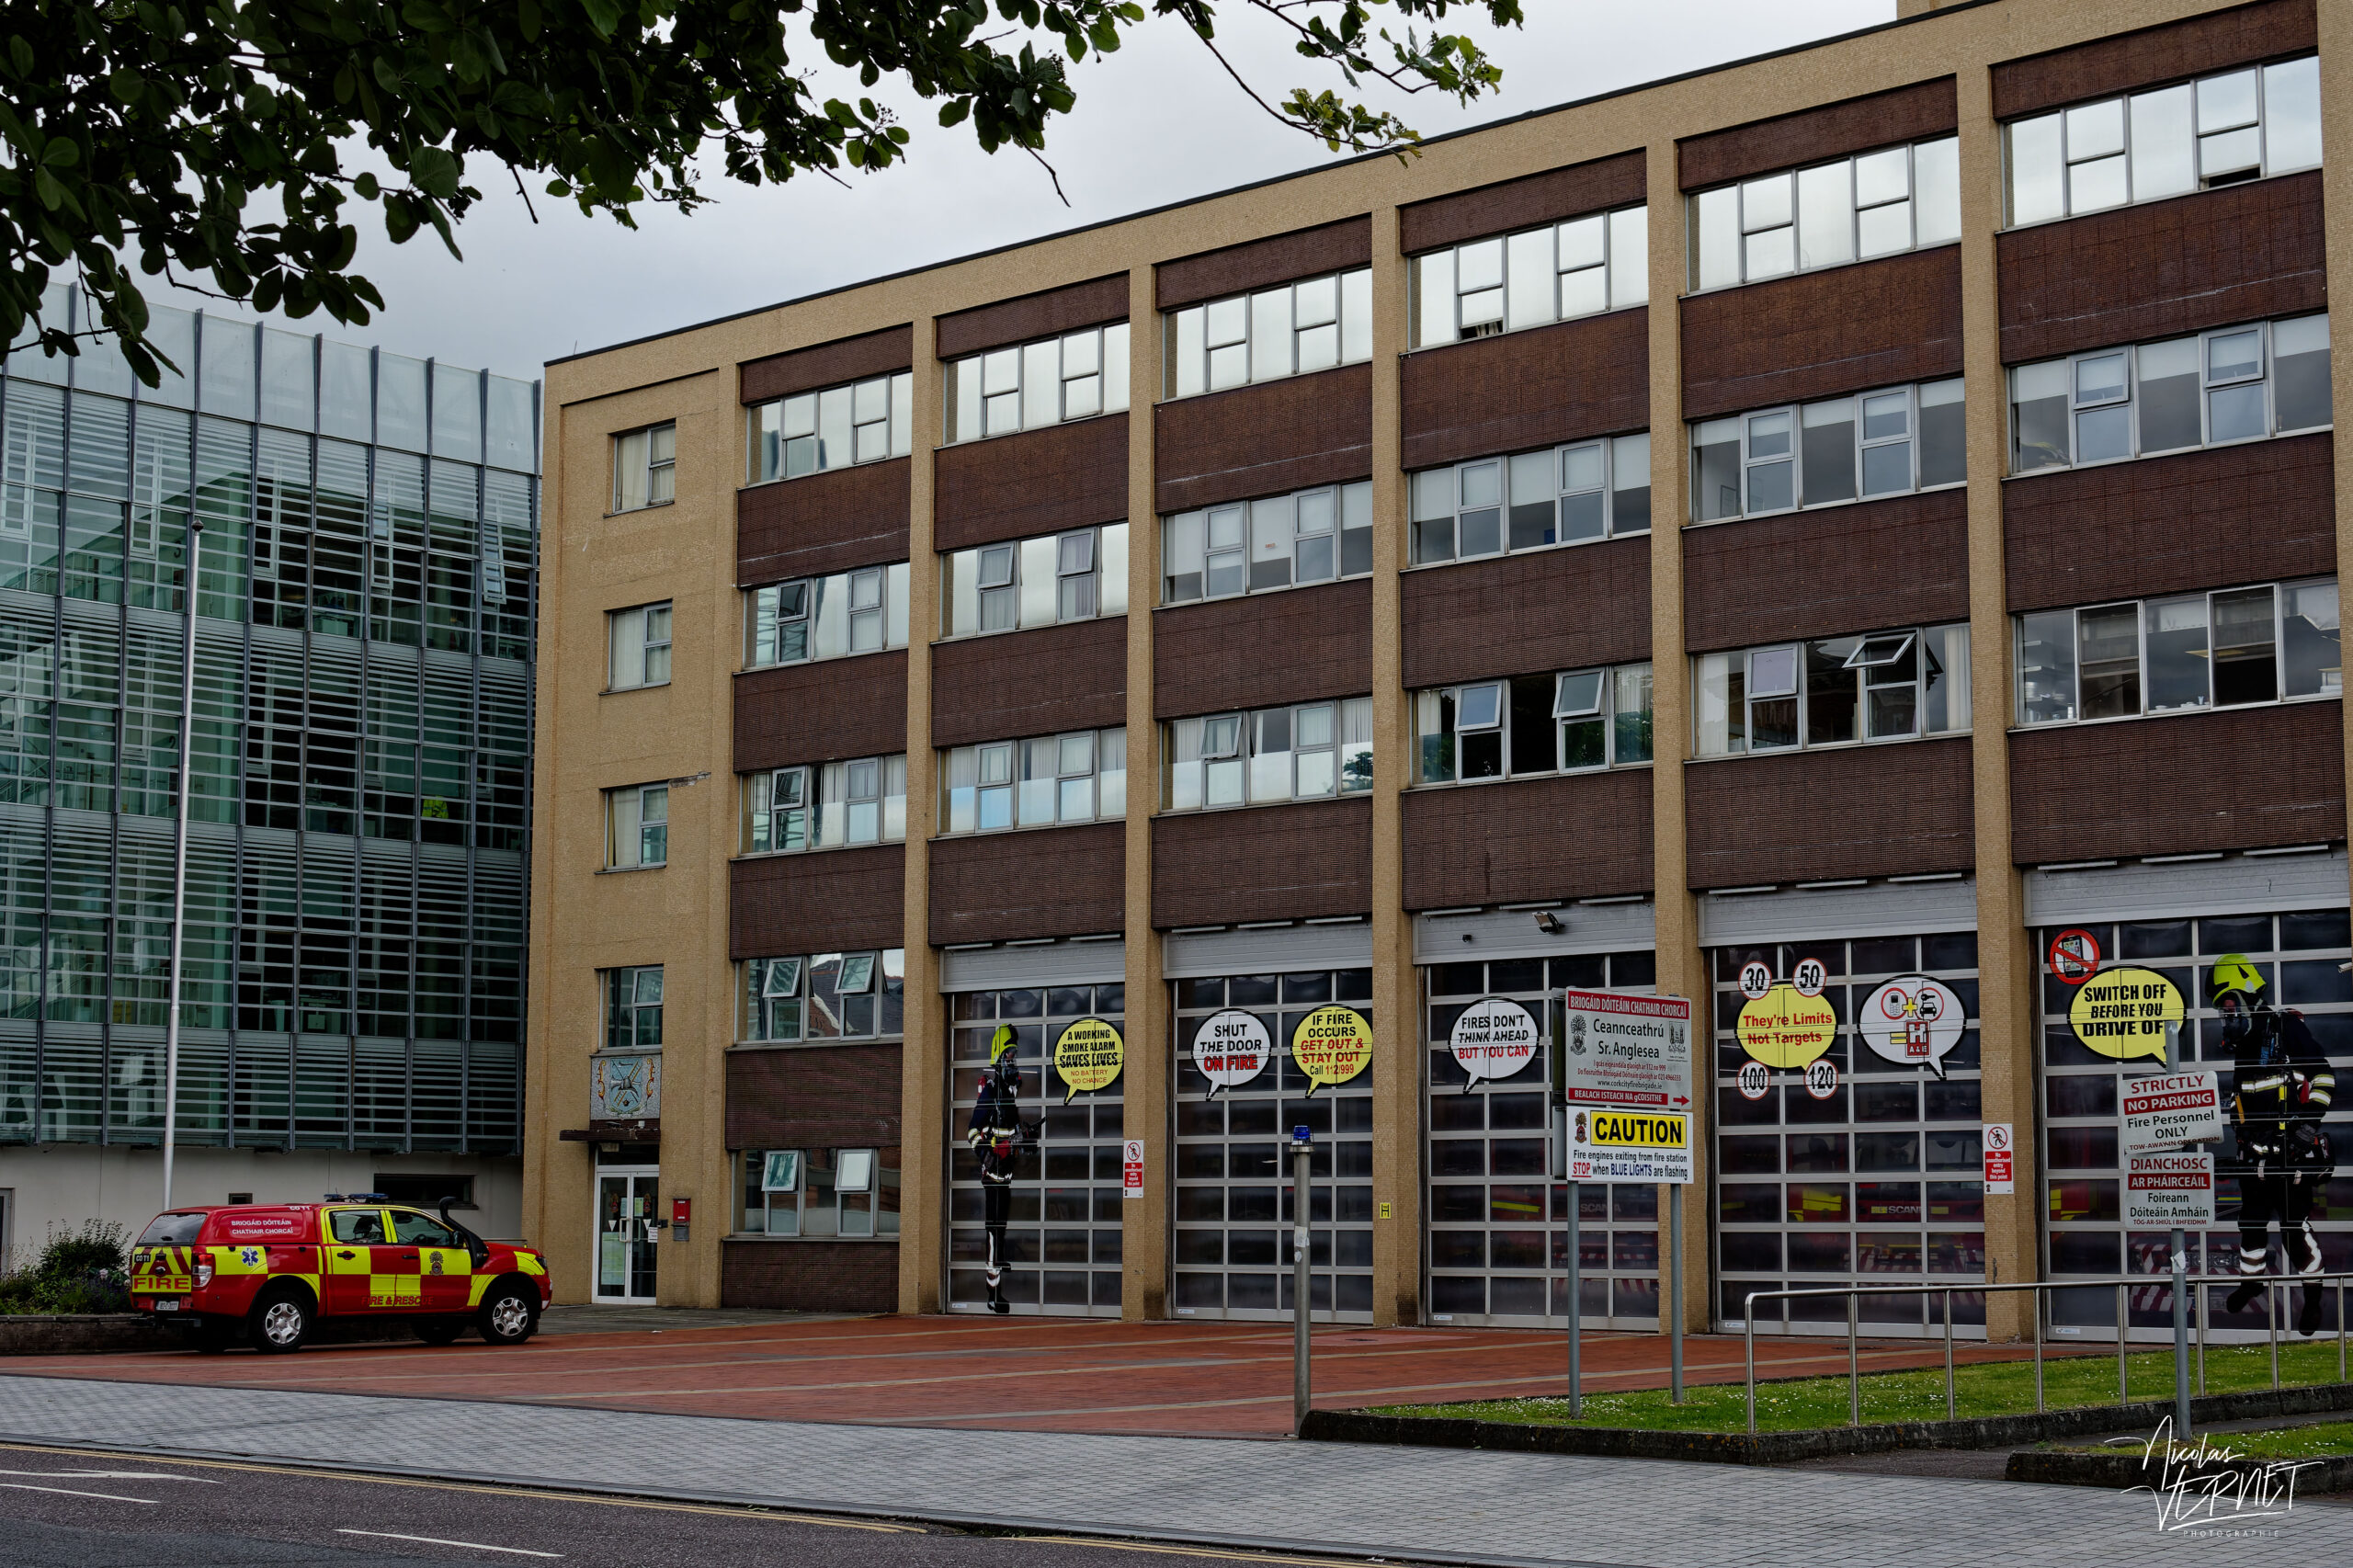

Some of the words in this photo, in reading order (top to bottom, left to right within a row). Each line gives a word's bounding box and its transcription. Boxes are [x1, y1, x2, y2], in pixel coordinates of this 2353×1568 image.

[1745, 968, 1766, 991] 30
[1799, 964, 1820, 988] 50
[2084, 985, 2139, 1002] SWITCH
[2143, 984, 2166, 999] OFF
[1570, 995, 1600, 1009] BRIOGÁID
[1601, 997, 1630, 1012] DÓITEÁIN
[1631, 1003, 1661, 1016] CHATHAIR
[1661, 1004, 1687, 1017] CHORCAÍ
[2091, 1004, 2135, 1018] BEFORE
[2138, 1003, 2163, 1017] YOU
[1313, 1015, 1323, 1026] IF
[1326, 1013, 1352, 1025] FIRE
[1461, 1017, 1490, 1029] FIRES
[1495, 1015, 1525, 1028] DON'T
[1744, 1015, 1790, 1028] They're
[1793, 1012, 1833, 1025] Limits
[1068, 1032, 1073, 1040] A
[1074, 1029, 1110, 1040] WORKING
[1214, 1024, 1247, 1038] SHUT
[1308, 1026, 1356, 1038] OCCURS
[1593, 1018, 1665, 1038] Ceannceathrú
[1909, 1023, 1927, 1043] H
[2083, 1021, 2136, 1037] DRIVE
[2142, 1020, 2164, 1035] OF
[1459, 1031, 1490, 1043] THINK
[1493, 1029, 1529, 1042] AHEAD
[1747, 1033, 1769, 1045] Not
[1773, 1031, 1823, 1046] Targets
[1063, 1042, 1089, 1052] SMOKE
[1090, 1041, 1116, 1051] ALARM
[1200, 1040, 1224, 1052] THE
[1227, 1039, 1262, 1051] DOOR
[1300, 1040, 1324, 1051] GET
[1327, 1039, 1352, 1050] OUT
[1356, 1038, 1363, 1049] &
[1598, 1040, 1611, 1055] Sr.
[1613, 1041, 1660, 1061] Anglesea
[1302, 1052, 1332, 1064] STAY
[1336, 1051, 1360, 1062] OUT
[1459, 1047, 1478, 1059] BUT
[1482, 1046, 1504, 1058] YOU
[1507, 1045, 1529, 1057] CAN
[1060, 1053, 1090, 1068] SAVES
[1092, 1052, 1118, 1066] LIVES
[1204, 1056, 1223, 1072] ON
[1226, 1054, 1258, 1070] FIRE
[1310, 1065, 1323, 1074] Call
[1742, 1067, 1766, 1090] 100
[1809, 1065, 1834, 1090] 120
[2131, 1074, 2204, 1094] STRICTLY
[1574, 1090, 1600, 1098] BEALACH
[1601, 1092, 1623, 1100] ISTEACH
[1634, 1094, 1662, 1102] gCOISITHE
[2128, 1100, 2148, 1112] NO
[2151, 1093, 2212, 1109] PARKING
[2127, 1118, 2150, 1129] Fire
[2153, 1109, 2214, 1126] Personnel
[1595, 1117, 1682, 1143] CAUTION
[2155, 1126, 2188, 1139] ONLY
[1574, 1150, 1586, 1159] Fire
[1587, 1151, 1613, 1162] engines
[1615, 1152, 1637, 1163] exiting
[1639, 1153, 1653, 1161] from
[1654, 1153, 1665, 1162] fire
[1666, 1153, 1687, 1162] station
[2131, 1158, 2208, 1170] DIANCHOSC
[1574, 1162, 1591, 1175] STOP
[1592, 1163, 1609, 1176] when
[1610, 1164, 1628, 1176] BLUE
[1629, 1164, 1652, 1176] LIGHTS
[1654, 1168, 1663, 1176] are
[1665, 1165, 1688, 1181] flashing
[2131, 1176, 2146, 1187] AR
[2147, 1175, 2208, 1187] PHÁIRCEÁIL
[2148, 1193, 2189, 1202] Foireann
[1580, 1203, 1621, 1213] SCANA
[2130, 1207, 2169, 1217] Dóiteáin
[2171, 1207, 2209, 1217] Amháin
[133, 1278, 189, 1290] FIRE
[361, 1296, 383, 1305] FIRE
[386, 1296, 392, 1305] &
[394, 1295, 434, 1305] RESCUE
